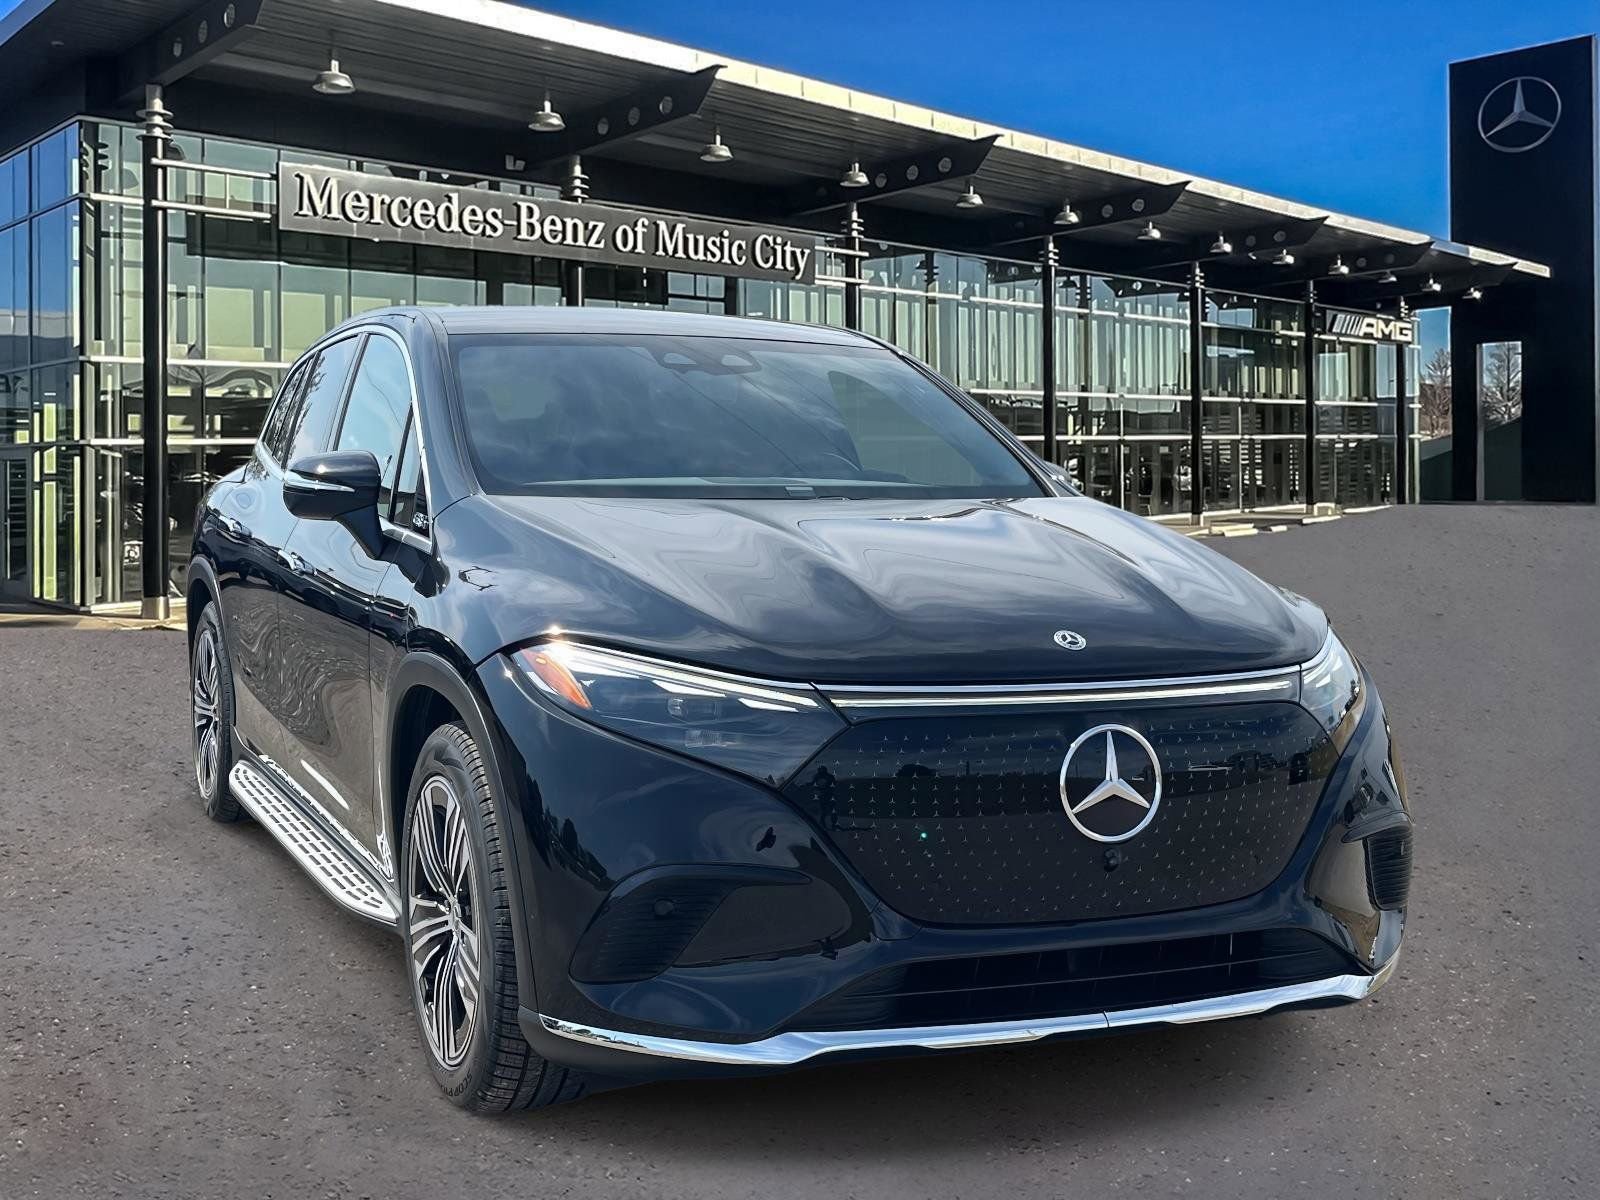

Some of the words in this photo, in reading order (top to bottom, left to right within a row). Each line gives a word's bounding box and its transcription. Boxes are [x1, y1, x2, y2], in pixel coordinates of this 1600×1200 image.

[294, 172, 605, 249] Mercedes-Benz
[614, 217, 649, 254] of
[654, 219, 747, 266] Music
[754, 234, 811, 280] City
